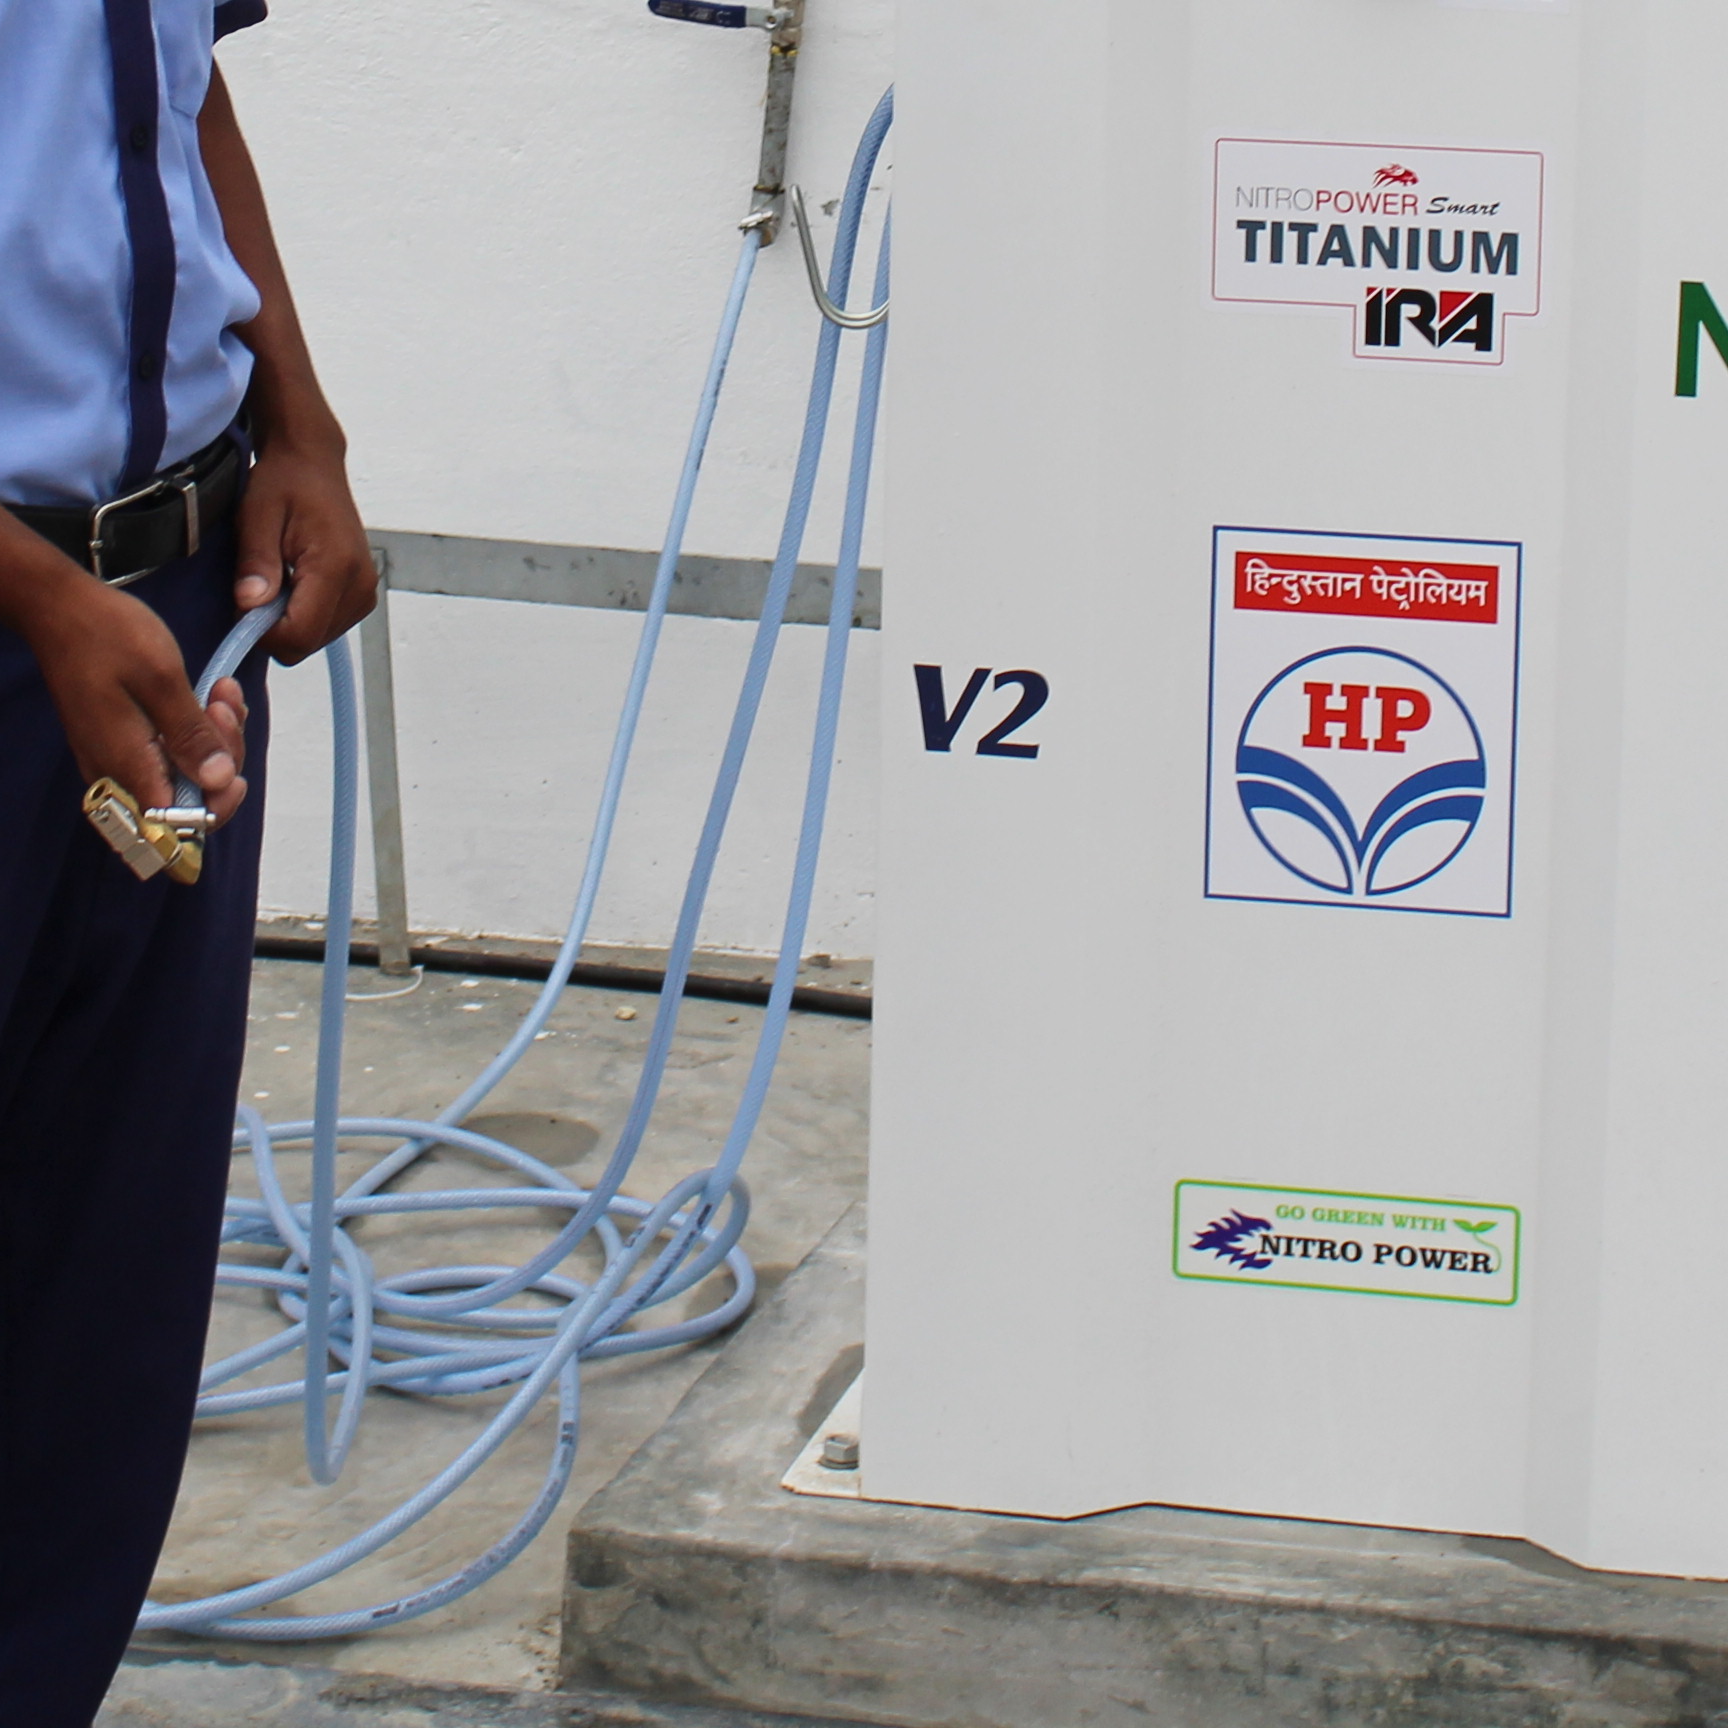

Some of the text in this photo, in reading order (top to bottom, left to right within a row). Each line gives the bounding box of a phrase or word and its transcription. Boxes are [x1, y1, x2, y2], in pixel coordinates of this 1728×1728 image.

[1235, 186, 1500, 216] NITROPOWER Smart
[1236, 219, 1519, 276] TITANIUM
[1364, 285, 1494, 352] IRA
[1245, 558, 1488, 610] हिन्दुस्तान पेट्रोलियम
[913, 663, 1050, 759] V2
[1302, 681, 1432, 753] HP
[1275, 1204, 1447, 1232] GO GREEN WITH
[1259, 1233, 1493, 1274] NITRO POWER
